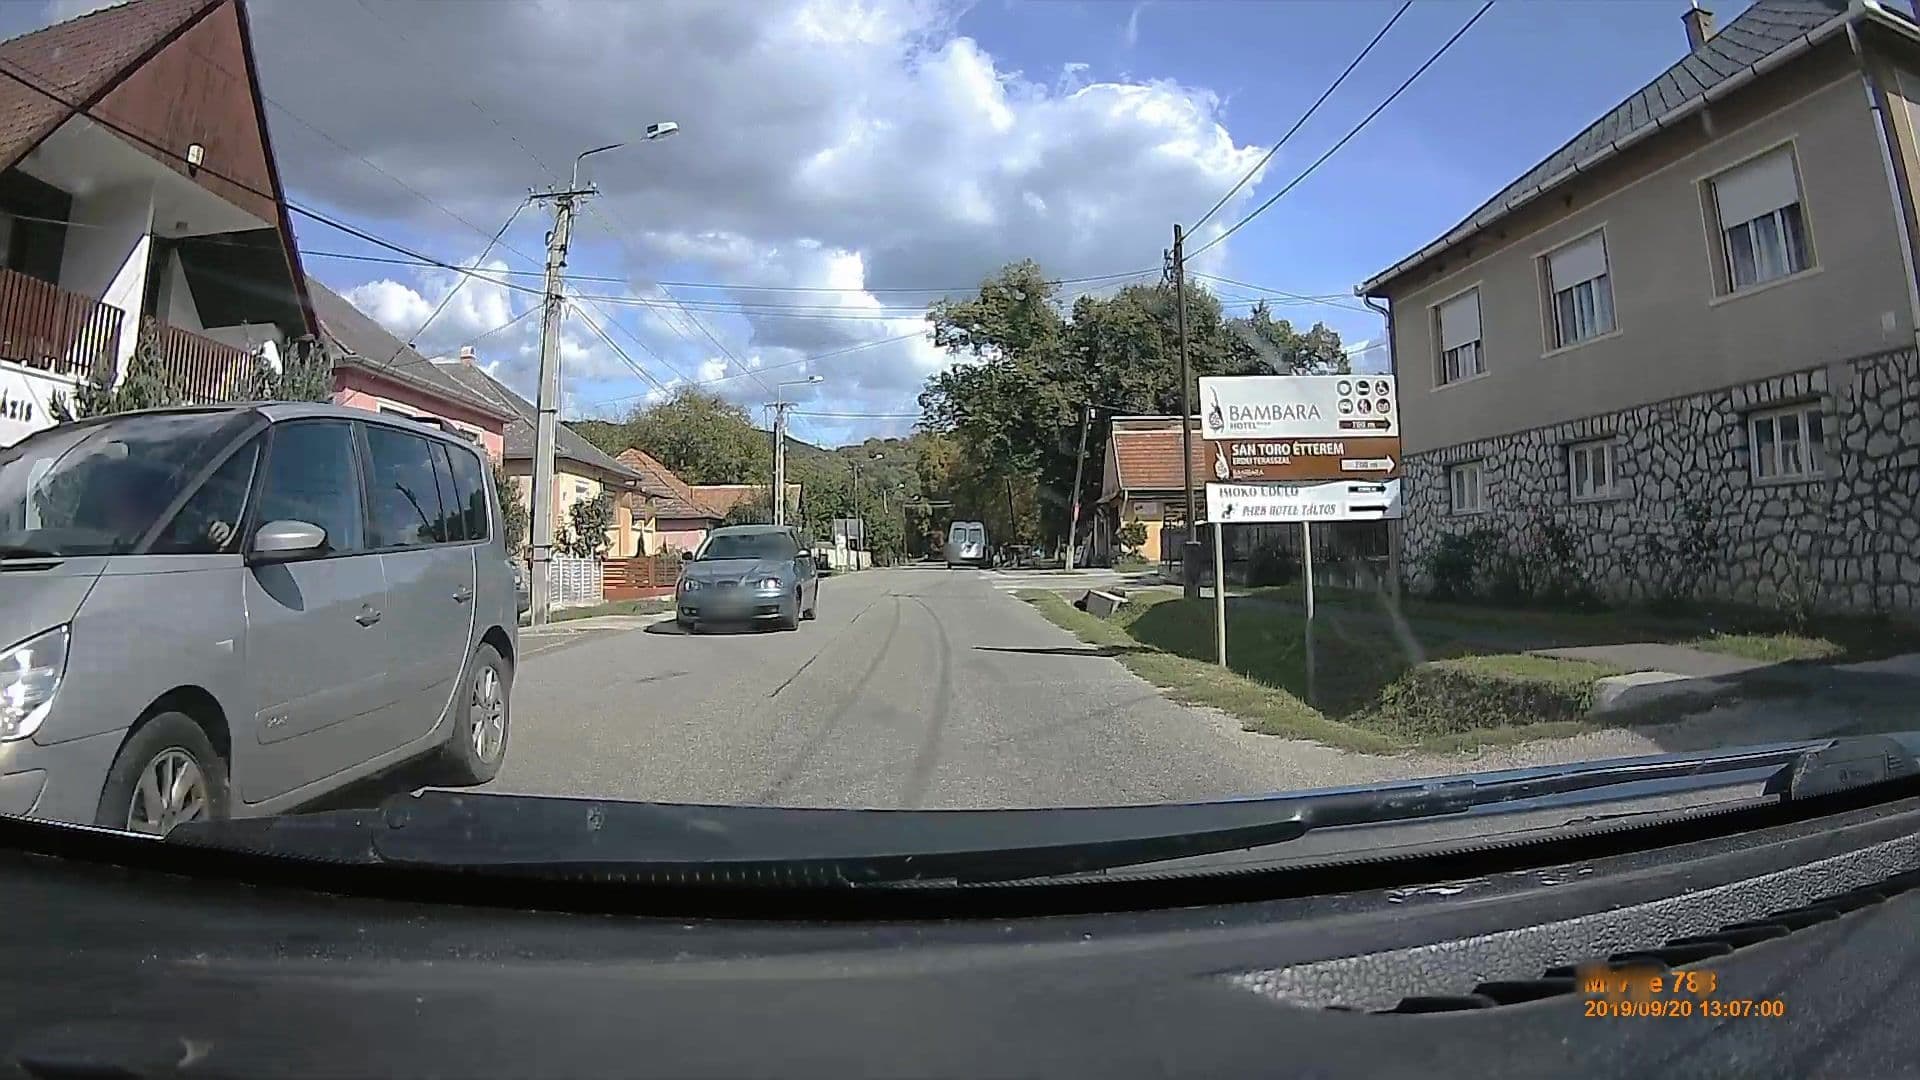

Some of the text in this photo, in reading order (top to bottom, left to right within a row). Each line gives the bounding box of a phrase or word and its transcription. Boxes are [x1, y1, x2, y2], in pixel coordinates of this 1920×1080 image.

[1229, 404, 1321, 421] BAMBARA
[1231, 441, 1345, 456] SAN TORO ÉTTEREM
[1242, 505, 1266, 516] PARK
[1270, 505, 1298, 516] HOTEL
